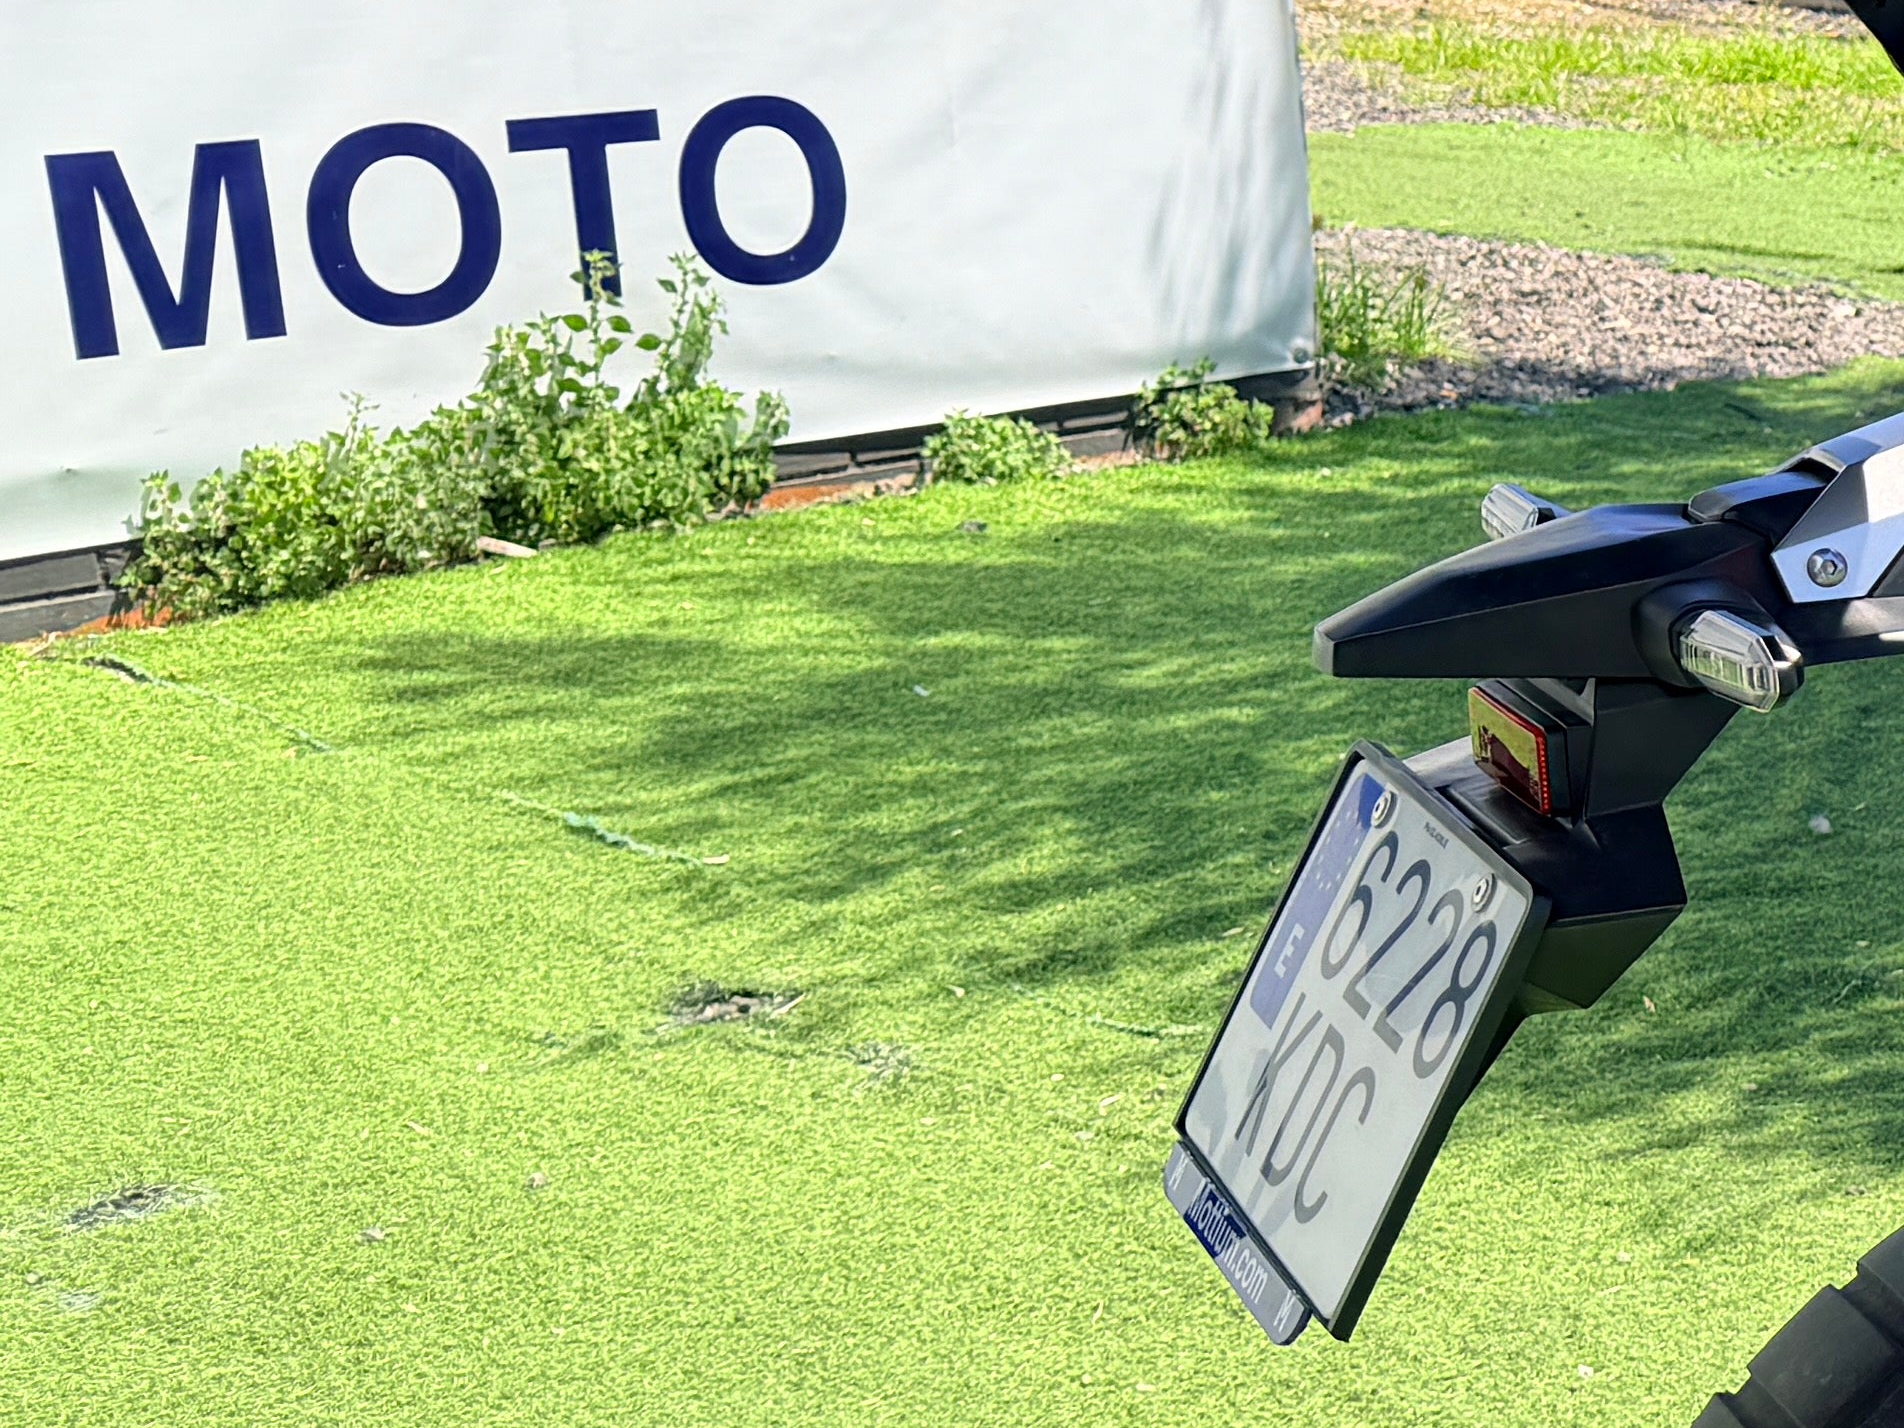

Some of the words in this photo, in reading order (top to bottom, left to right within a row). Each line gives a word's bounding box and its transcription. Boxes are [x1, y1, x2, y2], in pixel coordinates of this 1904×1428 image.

[44, 95, 848, 359] MOTO
[1273, 922, 1306, 978] E
[1320, 830, 1498, 1080] 6228
[1234, 992, 1376, 1224] KDC
